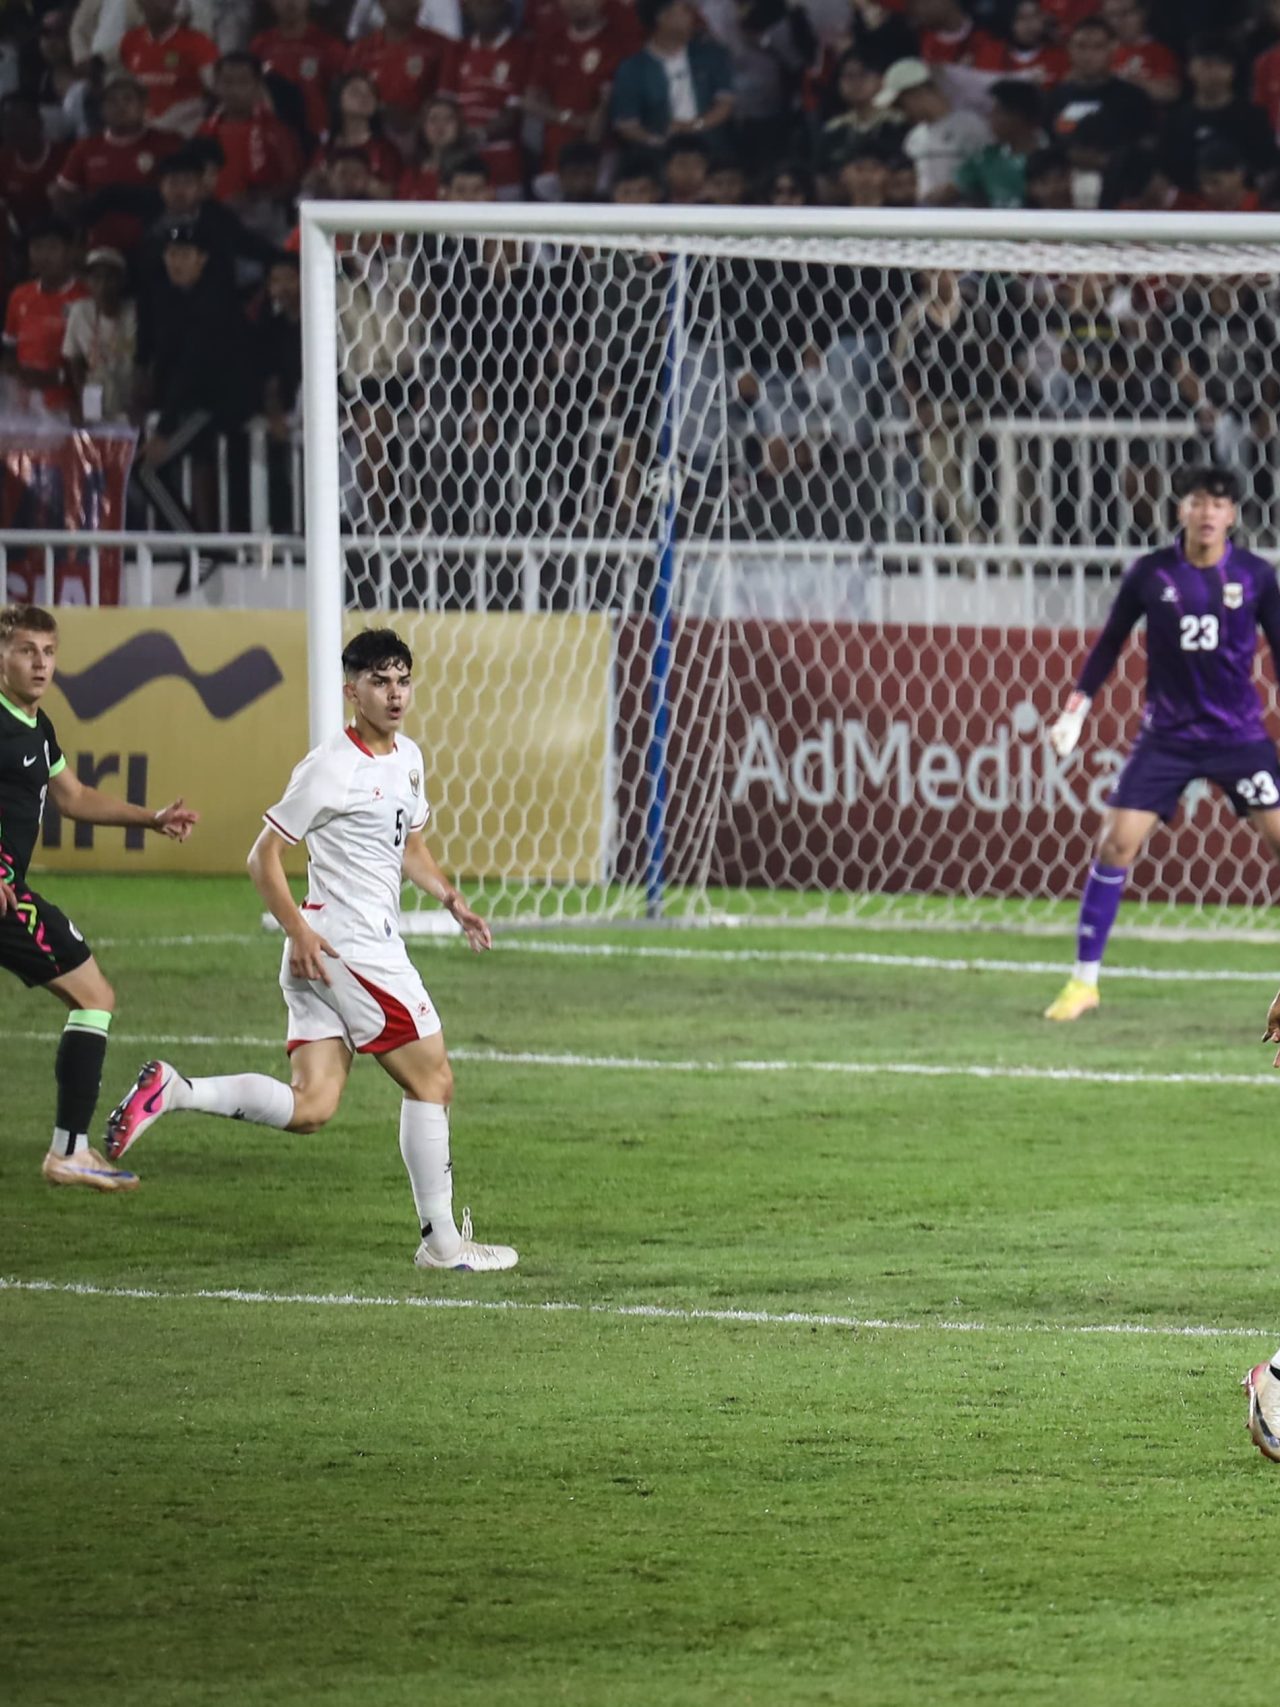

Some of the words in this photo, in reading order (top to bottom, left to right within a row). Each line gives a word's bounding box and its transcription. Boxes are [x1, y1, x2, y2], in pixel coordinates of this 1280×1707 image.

[1180, 614, 1219, 650] 23
[730, 701, 1130, 814] AdMedika
[1236, 770, 1280, 805] 23
[394, 808, 404, 847] 5
